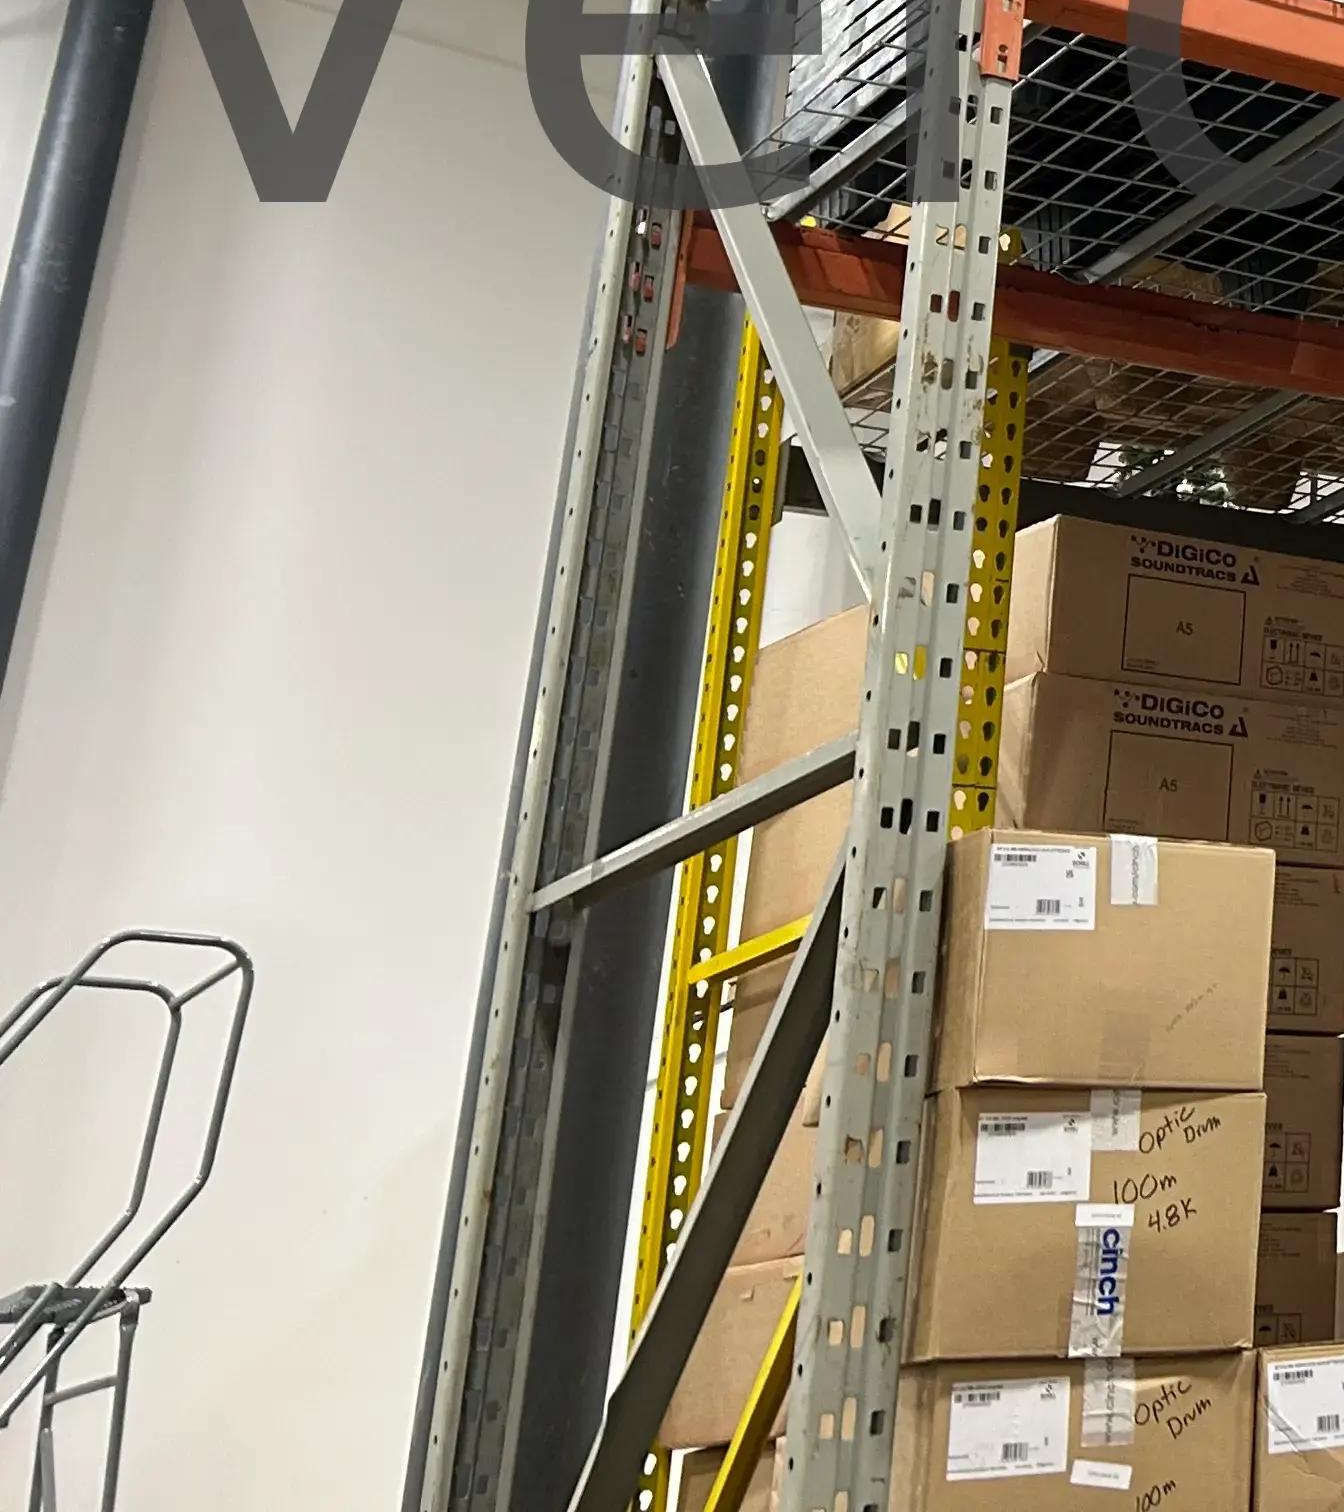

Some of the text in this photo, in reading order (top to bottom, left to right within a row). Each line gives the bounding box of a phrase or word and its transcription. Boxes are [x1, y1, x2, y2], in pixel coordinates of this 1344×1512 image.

[1130, 556, 1238, 583] SOUNDTRACS
[1175, 620, 1194, 636] A5
[1113, 710, 1224, 736] SOUNDTRACS
[1159, 777, 1178, 792] A5
[1138, 1105, 1196, 1154] Optic
[1183, 1115, 1222, 1144] Drum
[1113, 1173, 1177, 1205] 100m
[1096, 1227, 1125, 1316] cinch
[1134, 1380, 1192, 1426] Optic
[1167, 1398, 1213, 1439] Drum
